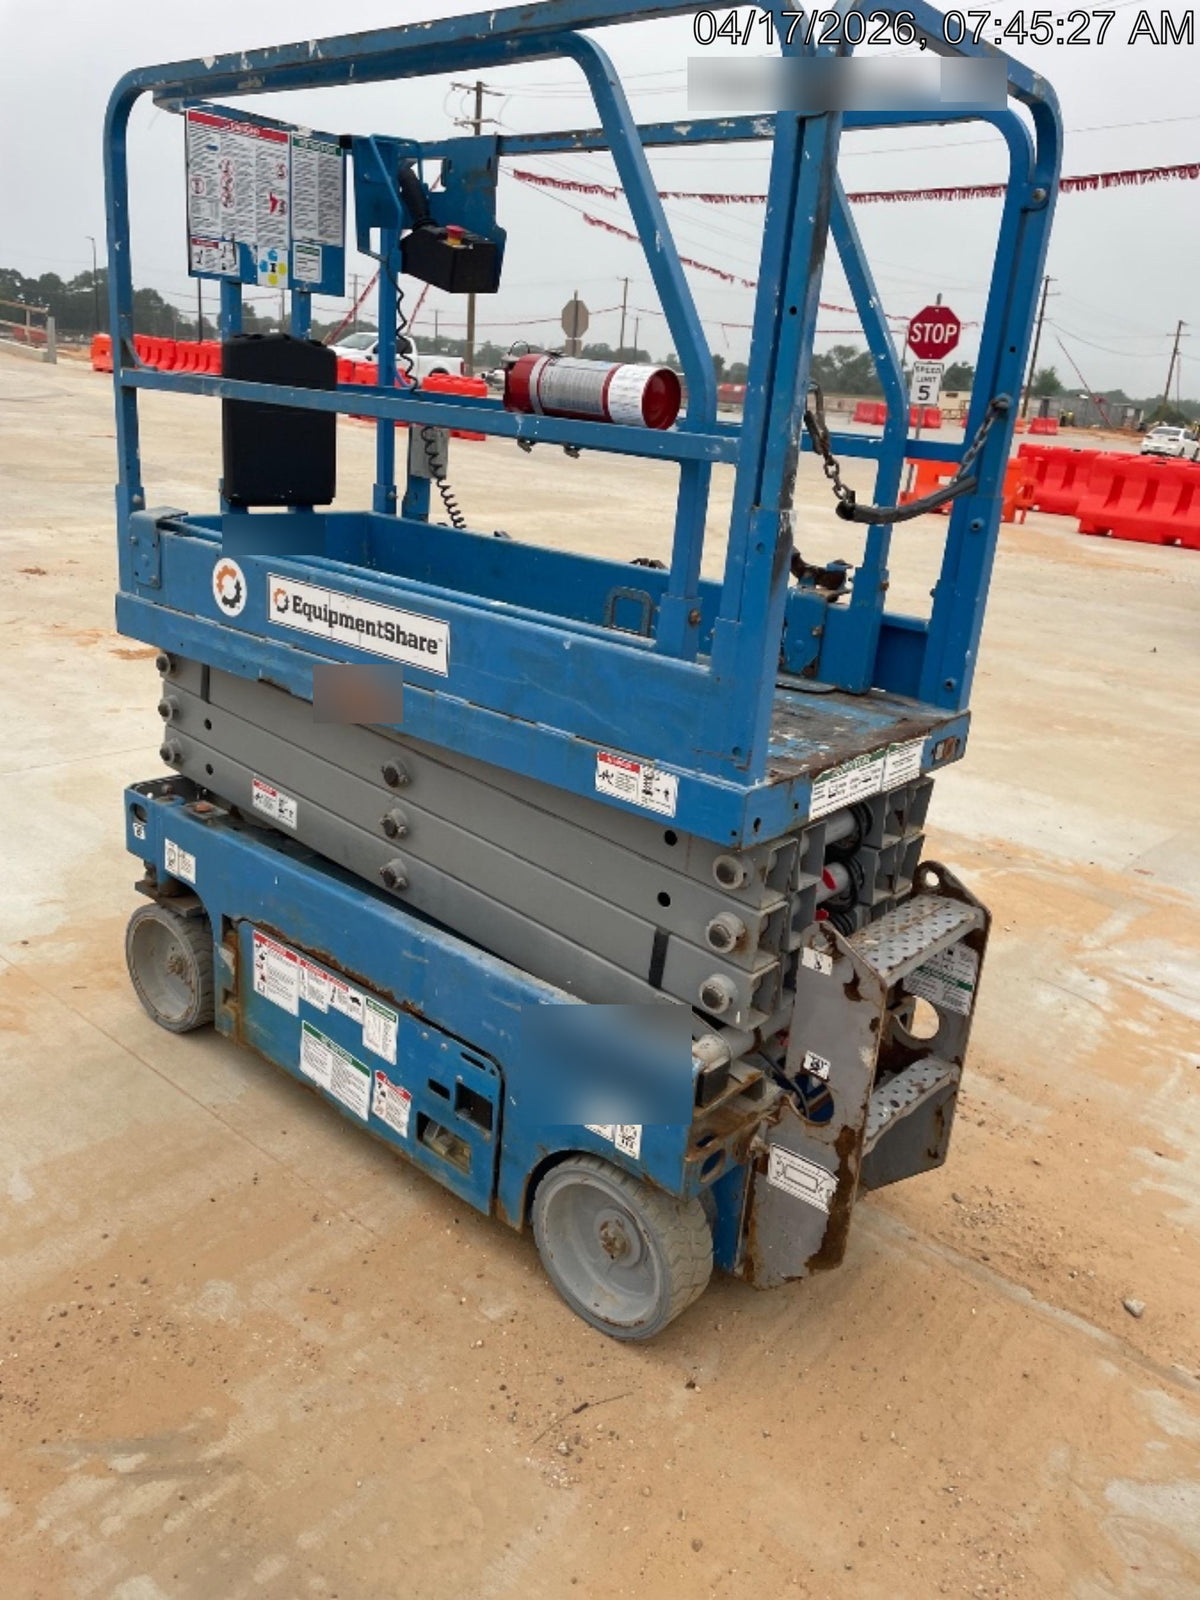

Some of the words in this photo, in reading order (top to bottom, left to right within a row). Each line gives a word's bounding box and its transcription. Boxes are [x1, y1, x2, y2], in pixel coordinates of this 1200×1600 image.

[910, 322, 958, 344] STOP
[915, 365, 941, 374] SPEED
[916, 375, 937, 383] LIMIT
[917, 385, 931, 401] 5
[291, 594, 439, 655] EquipmentShare
